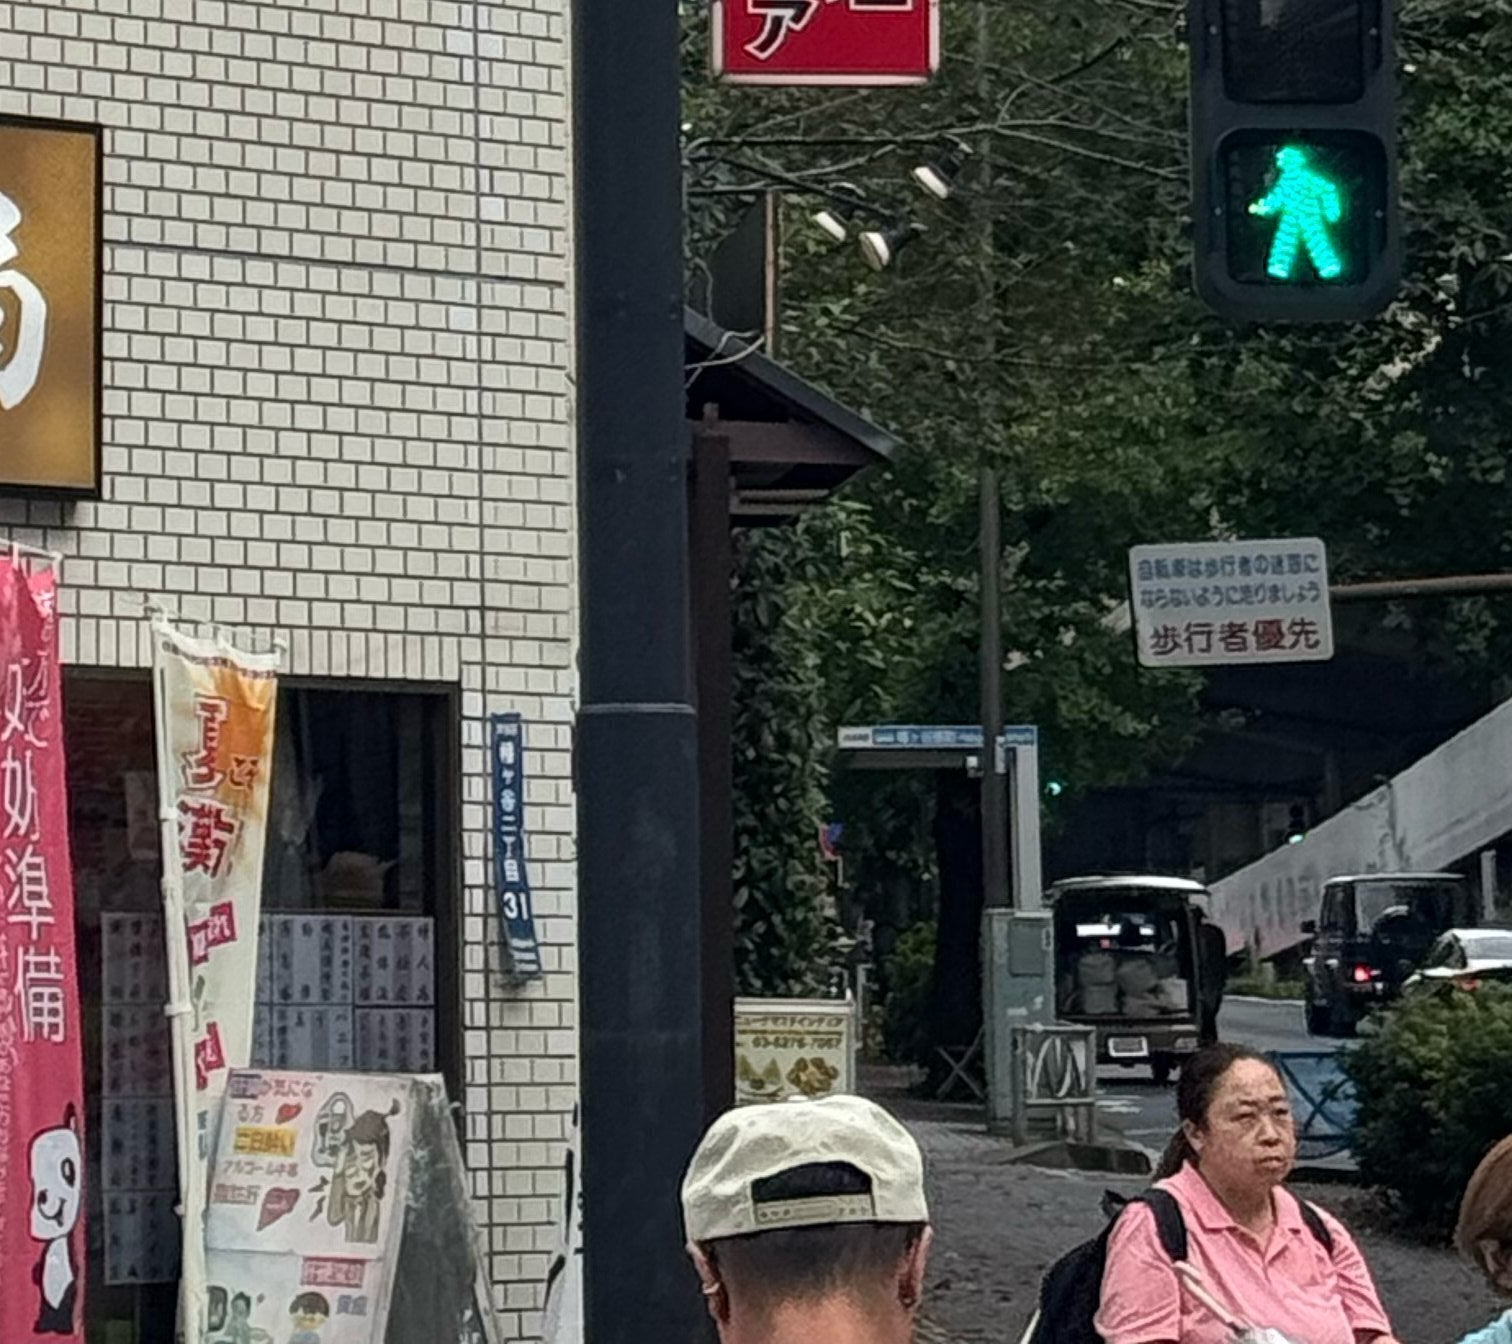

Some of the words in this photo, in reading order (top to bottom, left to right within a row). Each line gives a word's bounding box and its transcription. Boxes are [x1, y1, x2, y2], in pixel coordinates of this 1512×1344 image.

[1150, 617, 1321, 656] 歩行者優先
[502, 891, 530, 921] 31
